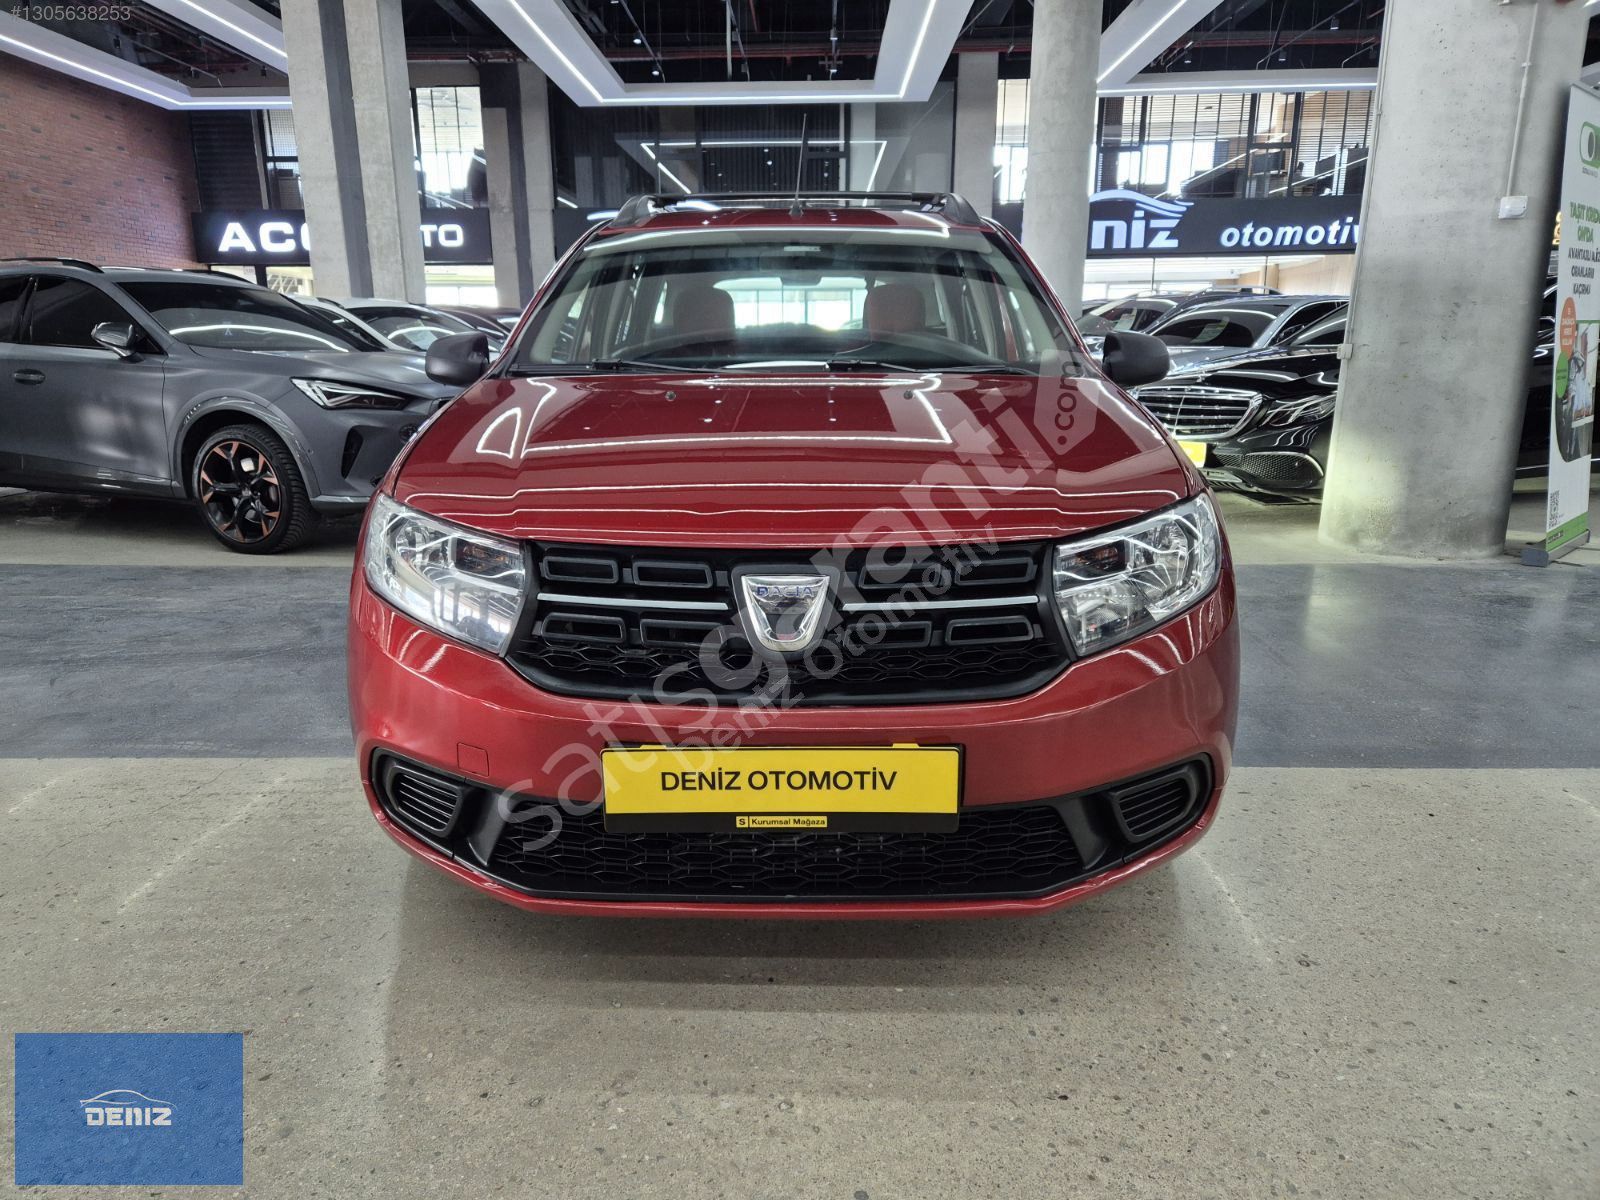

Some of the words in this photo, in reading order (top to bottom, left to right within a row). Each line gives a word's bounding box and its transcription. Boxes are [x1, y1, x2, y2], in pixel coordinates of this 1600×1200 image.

[756, 586, 814, 597] DACIA
[660, 767, 742, 791] DENİZ
[747, 767, 898, 791] OTOMOTİV
[751, 818, 791, 826] Kurumsal
[793, 818, 826, 827] Mağaza
